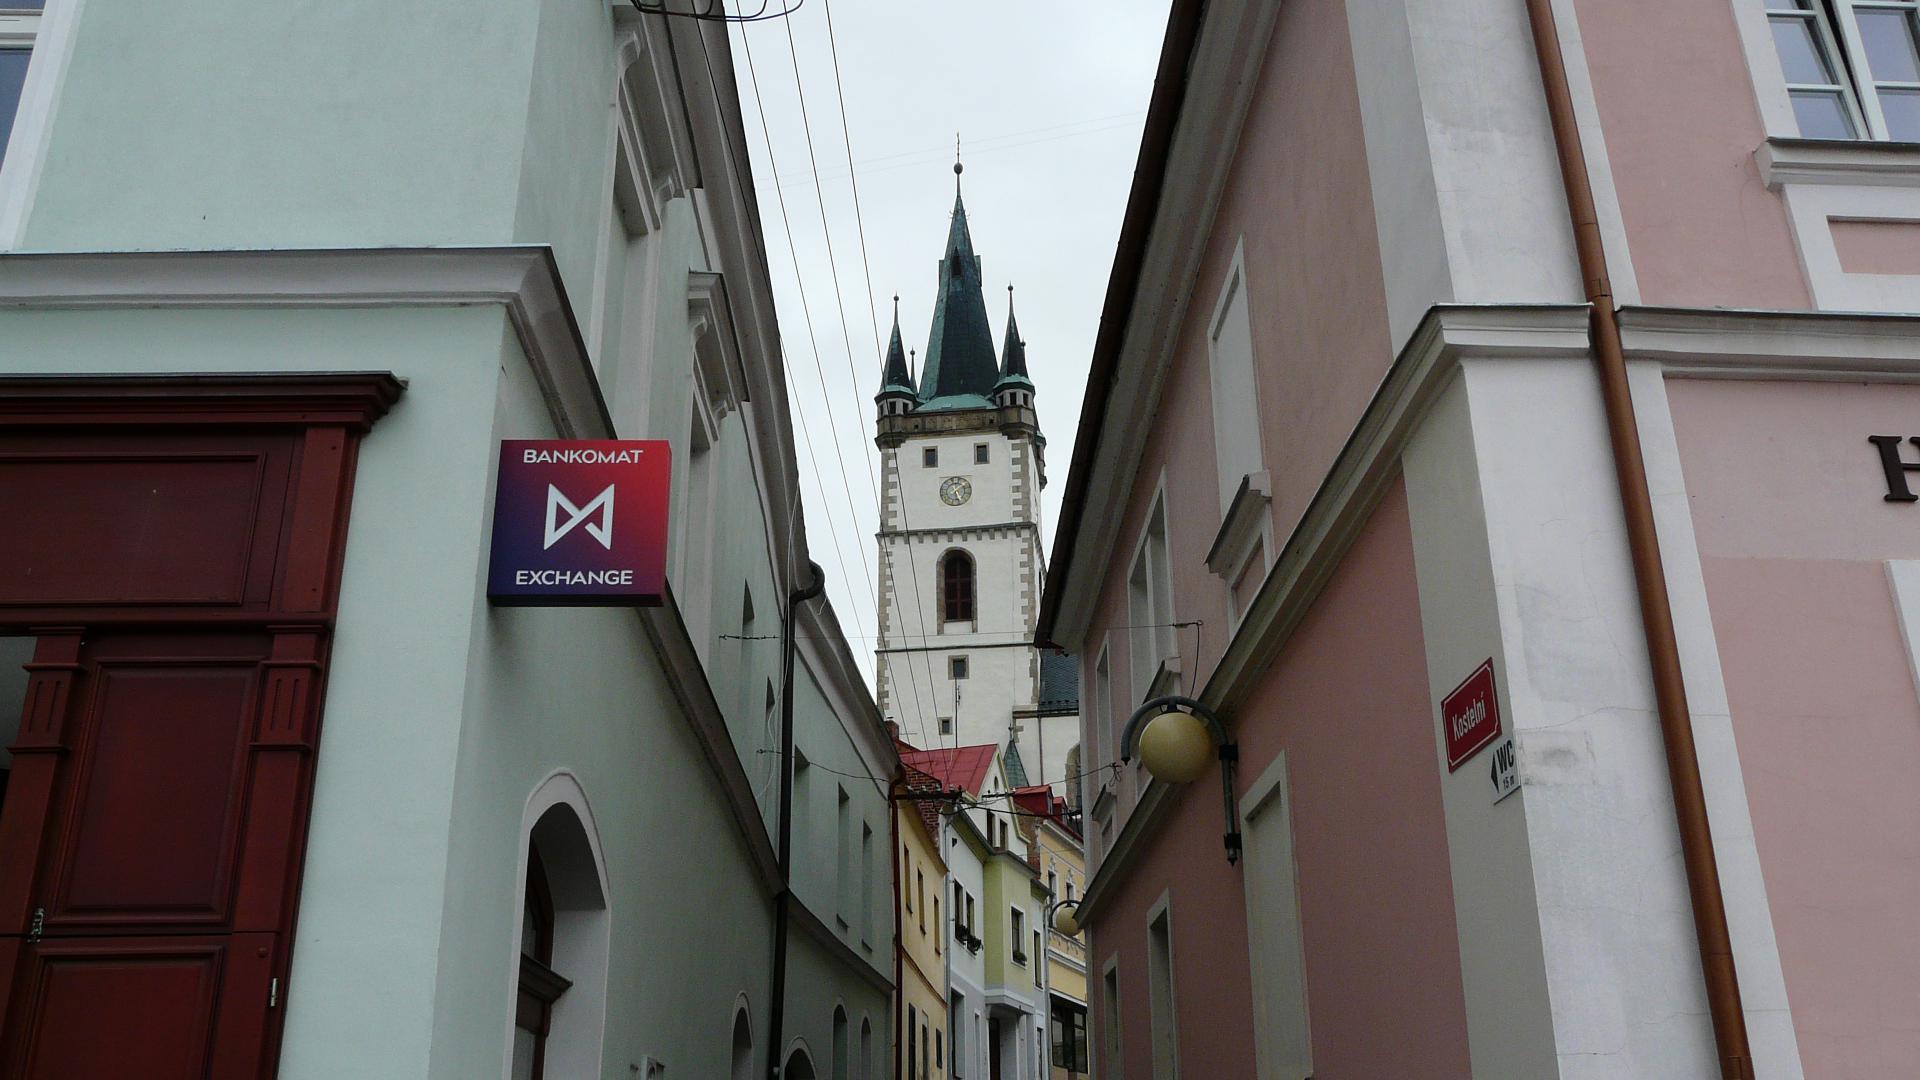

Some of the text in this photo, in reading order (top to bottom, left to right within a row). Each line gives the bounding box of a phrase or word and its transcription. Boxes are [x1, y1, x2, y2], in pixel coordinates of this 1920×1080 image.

[523, 449, 643, 464] BANKOMAT
[515, 570, 633, 585] EXCHANGE
[1452, 691, 1486, 741] Kostelní
[1496, 739, 1514, 774] WC
